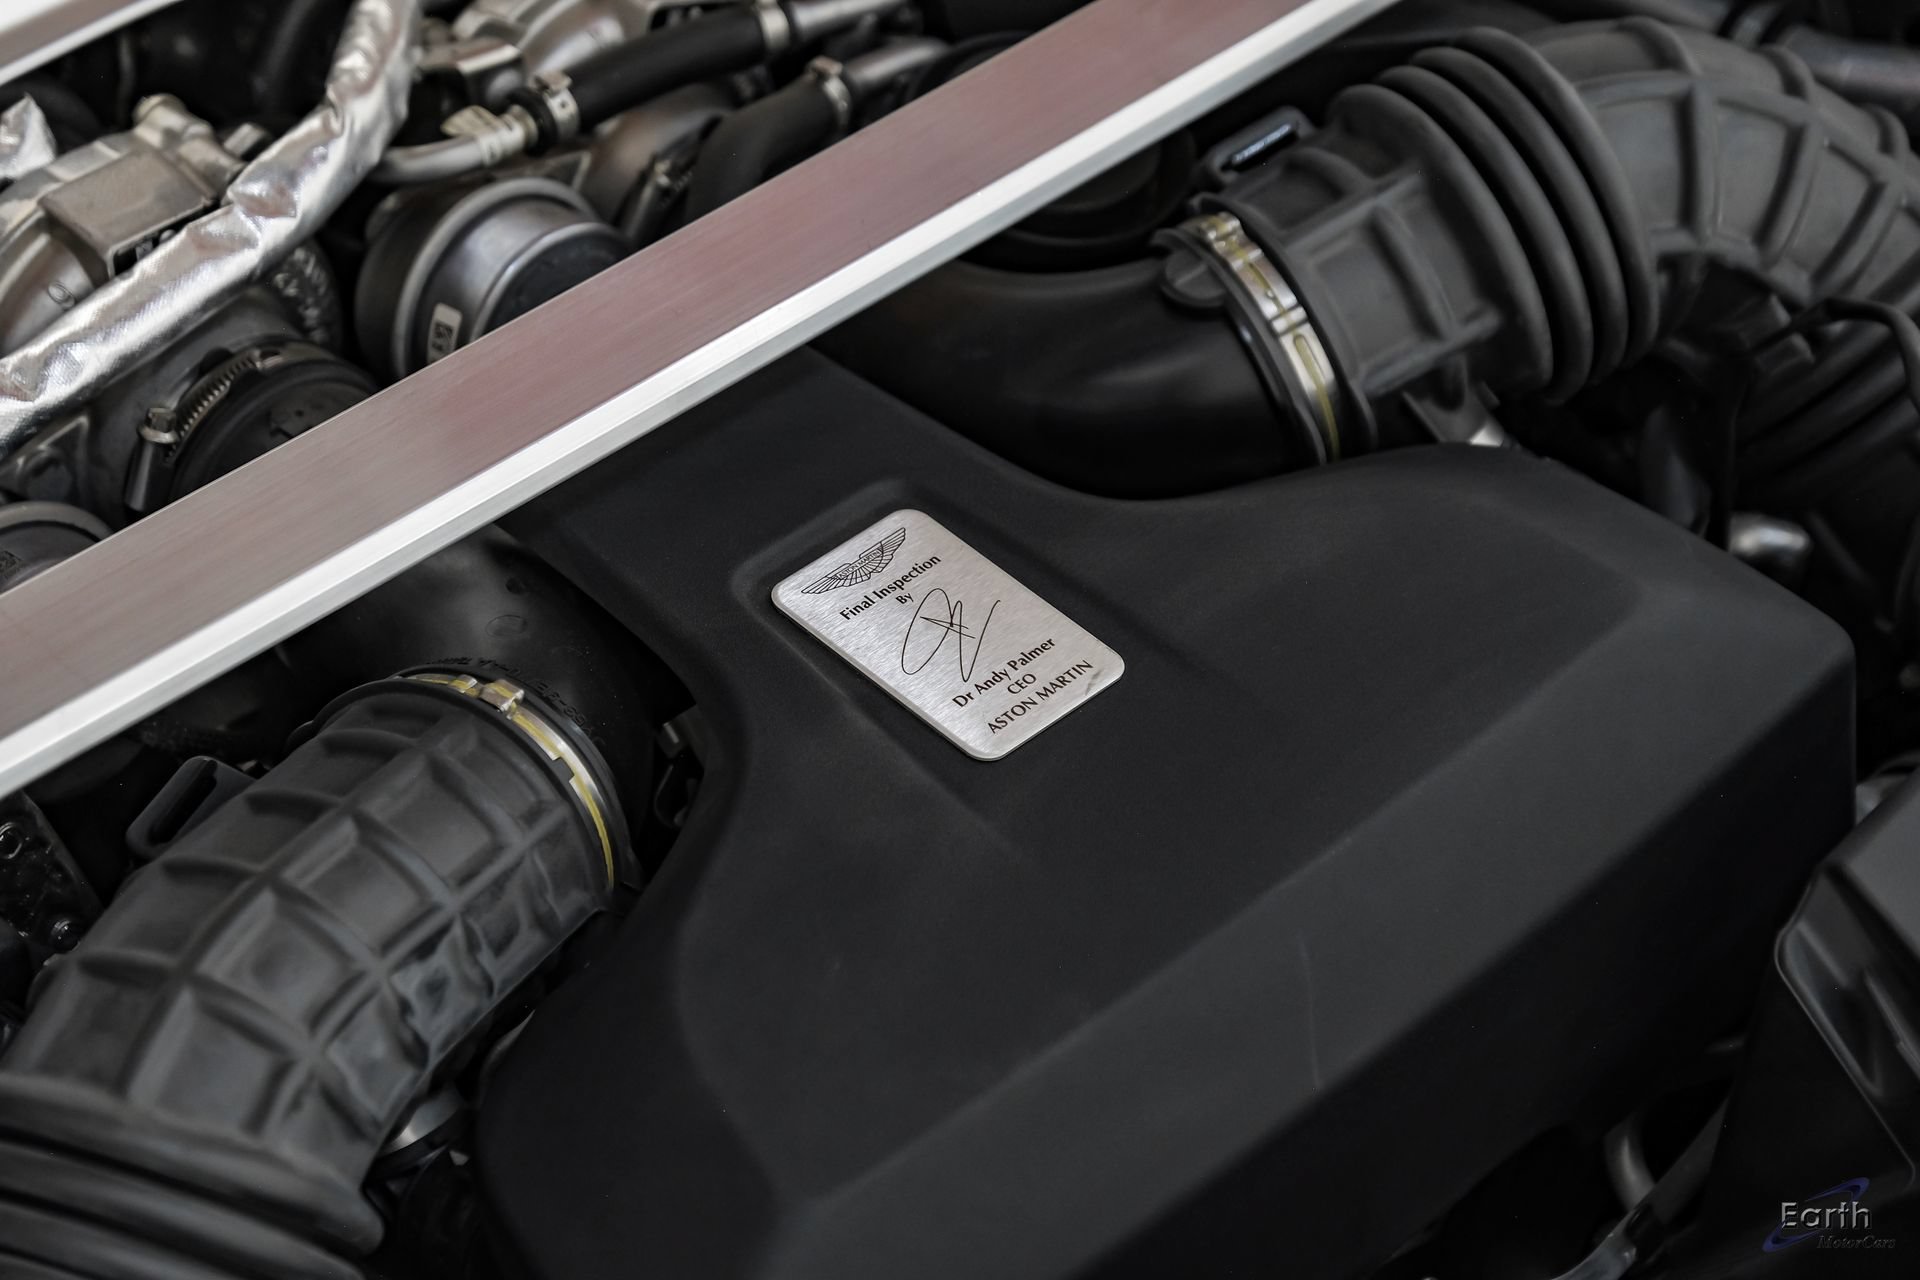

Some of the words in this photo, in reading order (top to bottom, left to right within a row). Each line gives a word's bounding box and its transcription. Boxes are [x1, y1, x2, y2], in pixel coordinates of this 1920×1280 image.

[839, 564, 859, 580] ASTON
[857, 550, 881, 566] MARTIN
[839, 594, 876, 621] Final
[874, 554, 941, 601] Inspection
[896, 592, 914, 605] By
[952, 690, 975, 709] Dr
[975, 664, 1013, 695] Andy
[1007, 636, 1056, 676] Palmer
[987, 696, 1040, 735] ASTON
[1038, 658, 1094, 703] MARTIN
[1007, 673, 1037, 696] CEO
